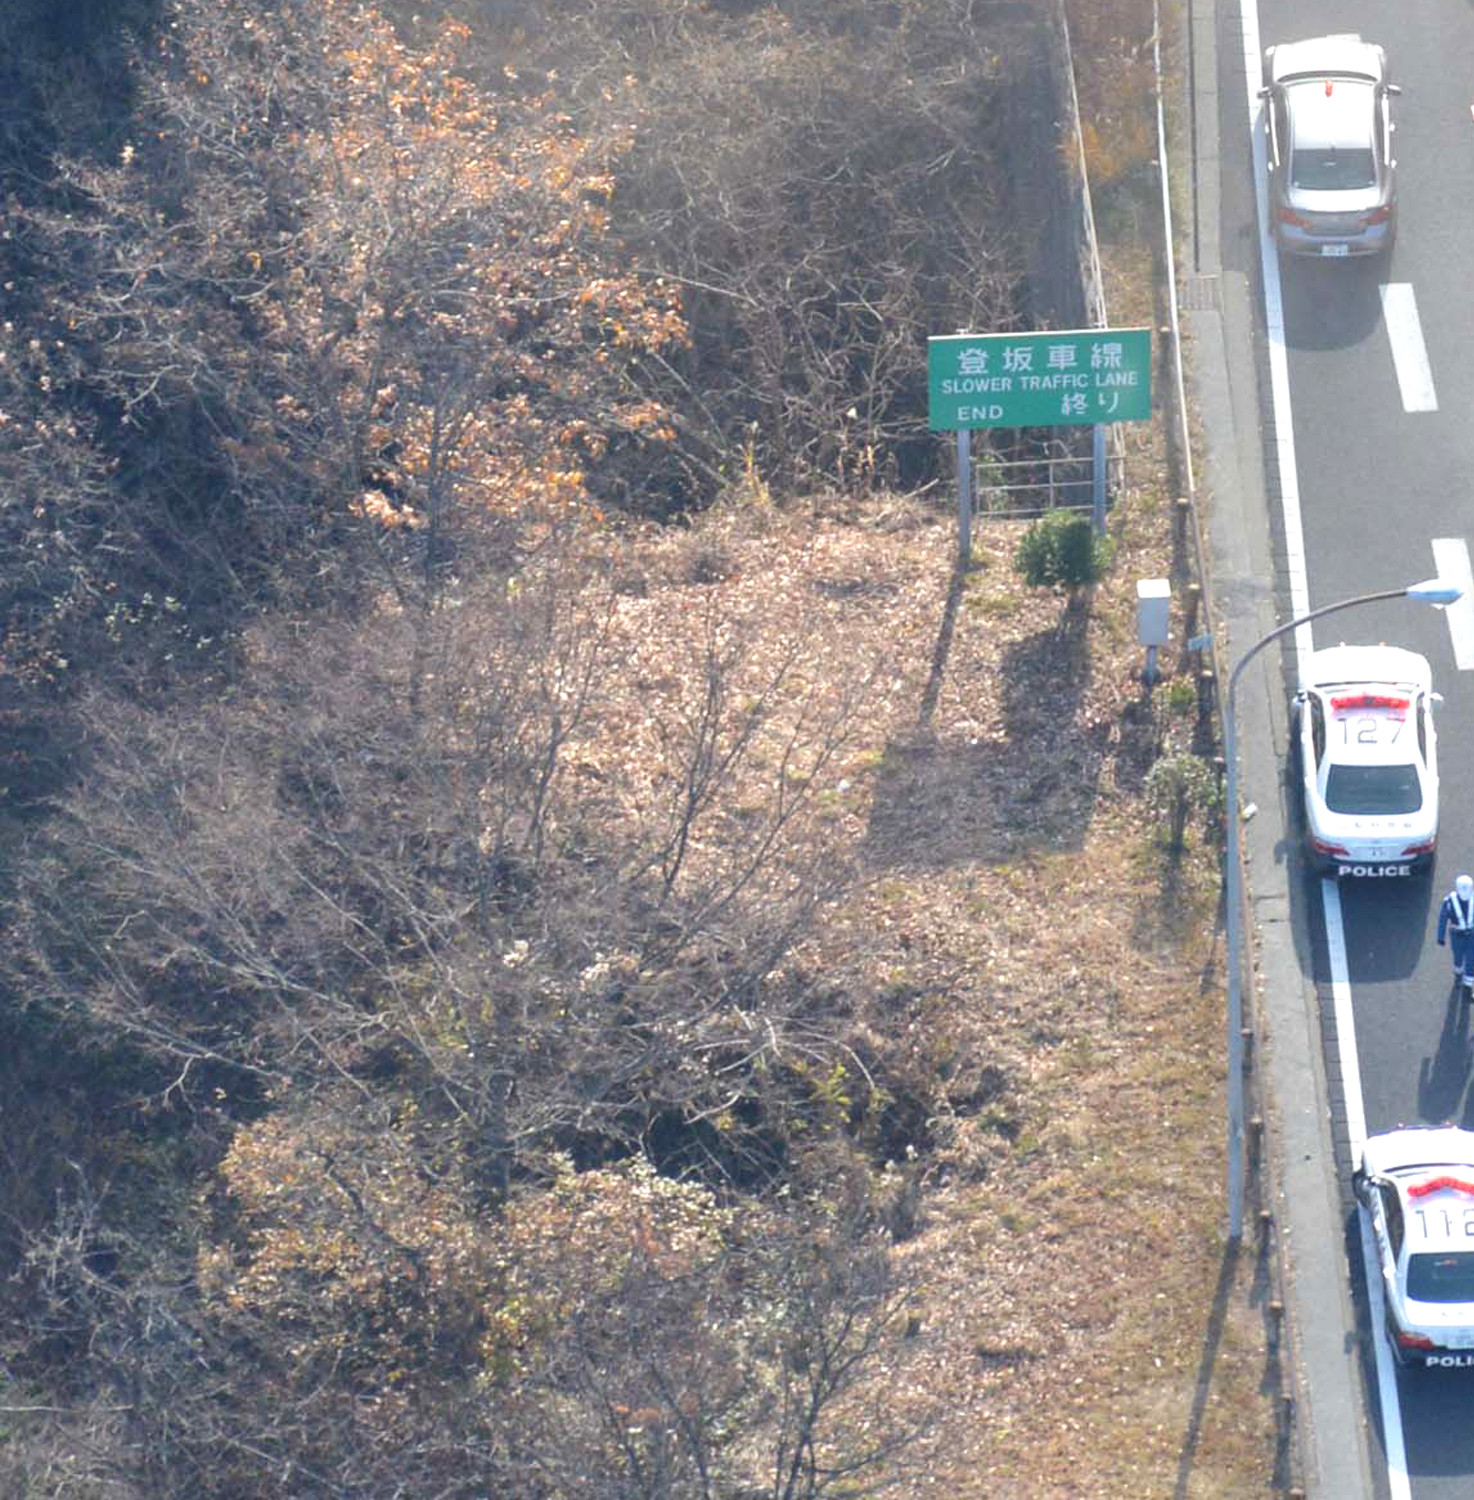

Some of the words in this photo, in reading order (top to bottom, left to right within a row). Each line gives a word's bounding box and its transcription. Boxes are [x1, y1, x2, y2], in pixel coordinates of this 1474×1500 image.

[957, 342, 1123, 375] 登坂車線
[942, 377, 1012, 394] SLOWER
[1021, 373, 1089, 390] TRAFFIC
[1096, 371, 1138, 386] LANE
[957, 404, 1003, 421] END
[1061, 392, 1119, 415] 終り
[1338, 864, 1411, 877] POLICE
